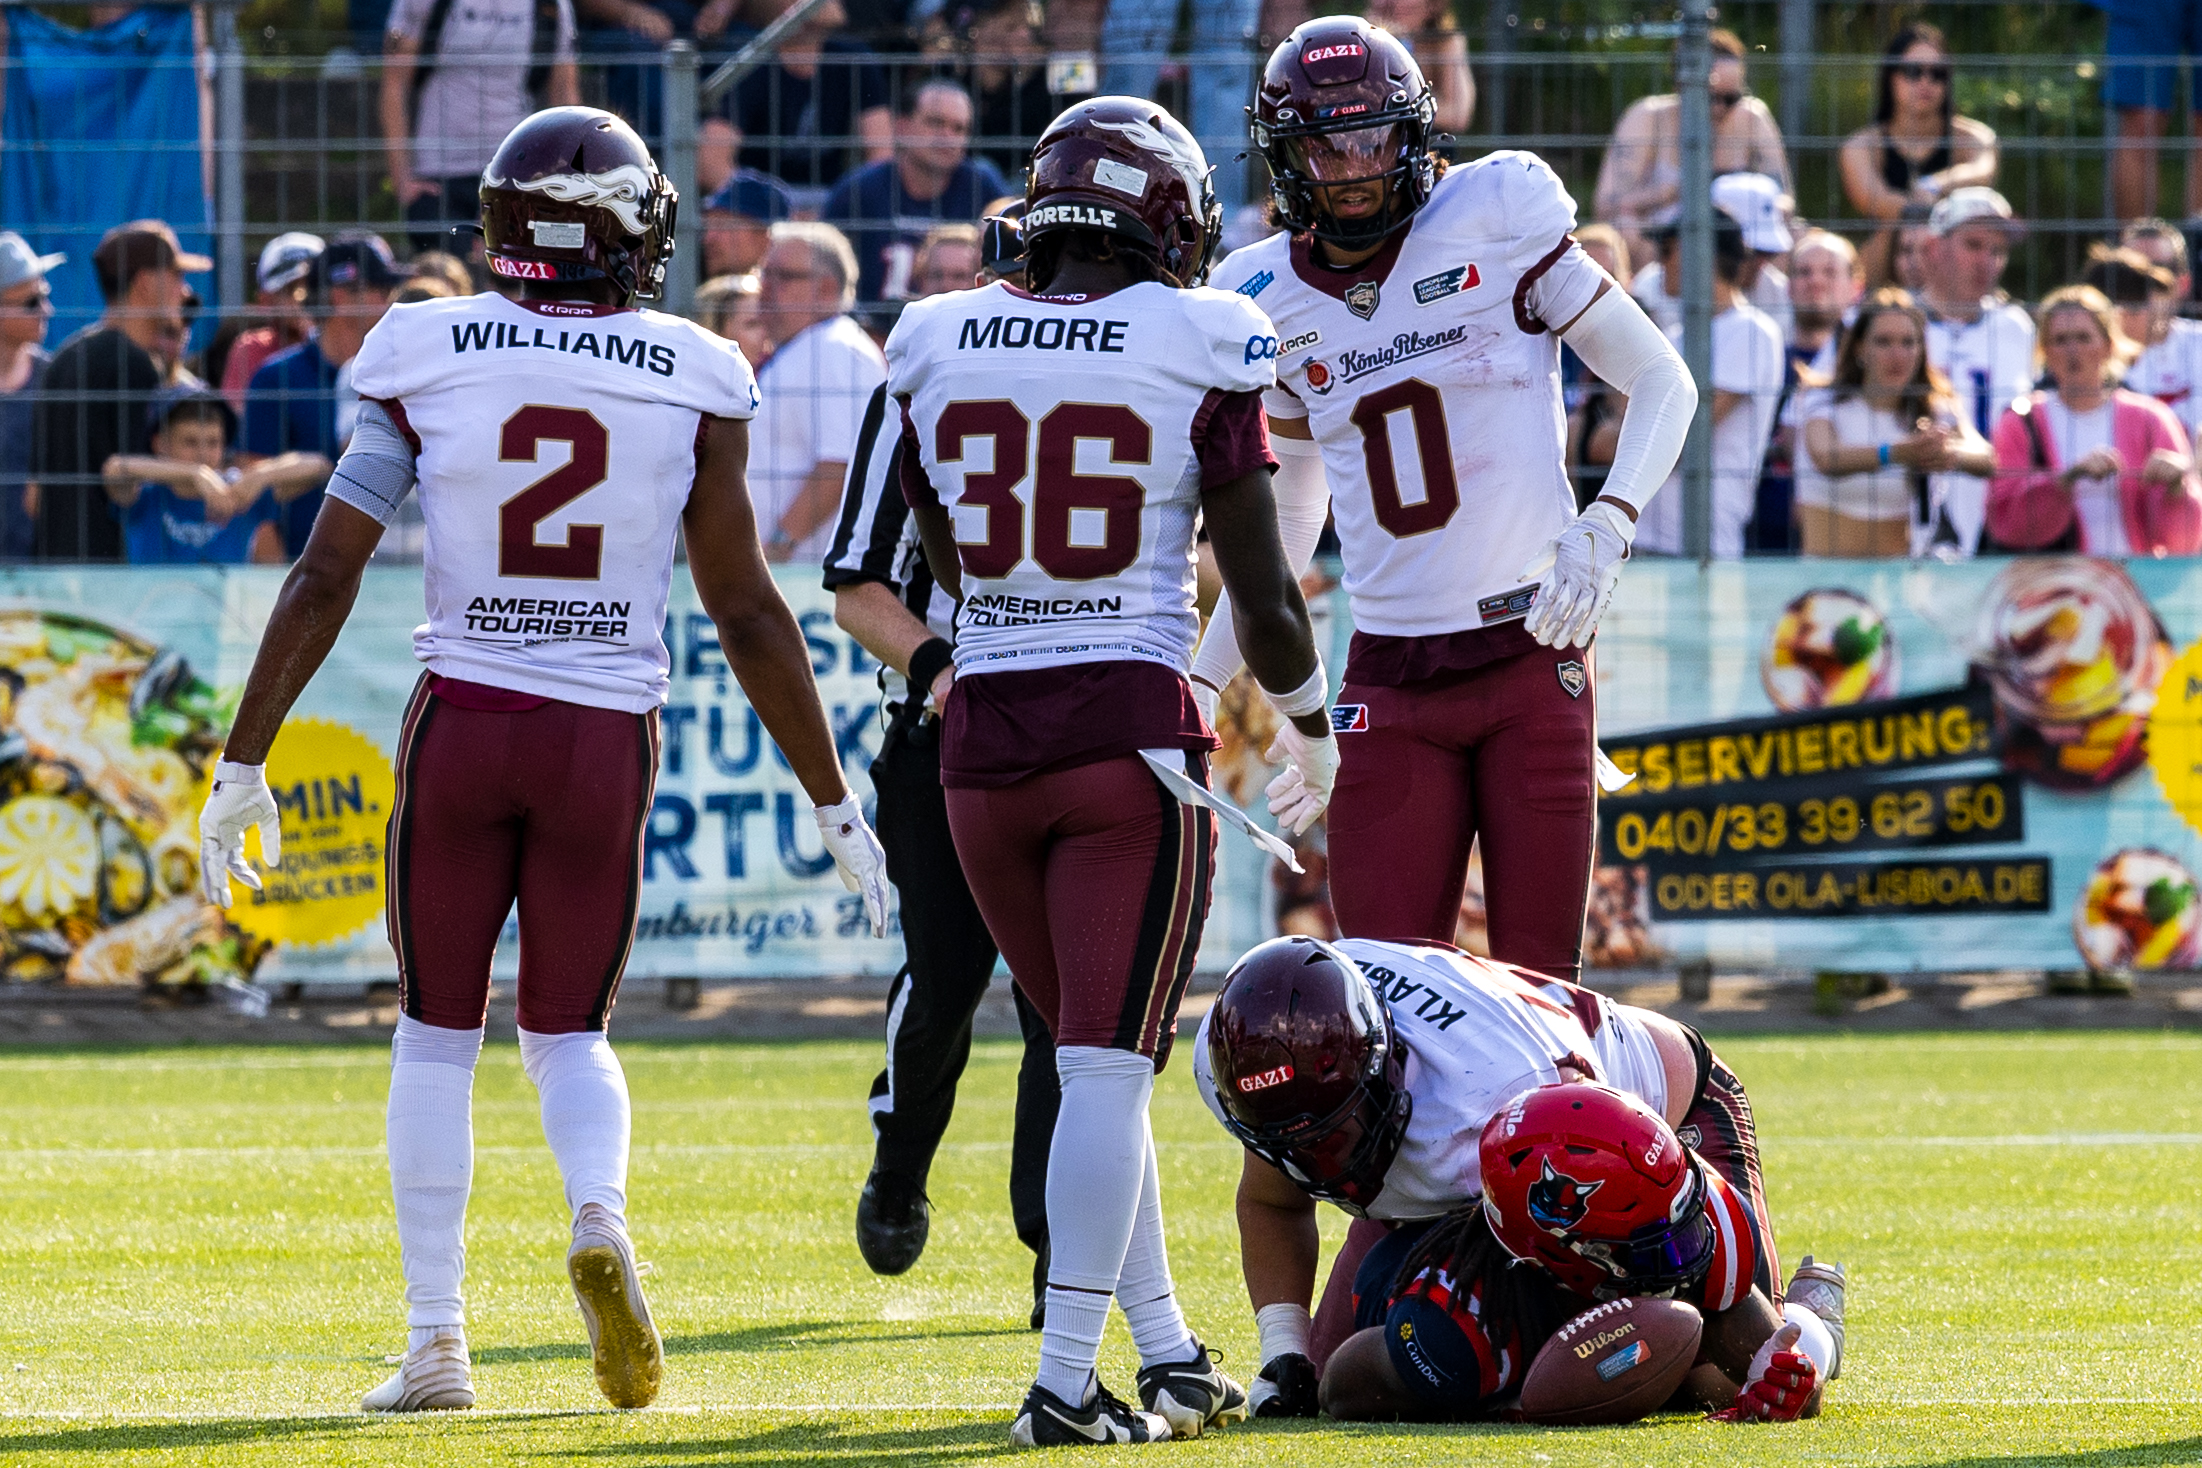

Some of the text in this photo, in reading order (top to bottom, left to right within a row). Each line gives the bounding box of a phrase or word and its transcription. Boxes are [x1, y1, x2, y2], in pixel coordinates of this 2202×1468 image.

[1026, 206, 1117, 231] FORELLE
[452, 321, 677, 377] WILLIAMS
[958, 316, 1129, 353] MOORE
[1350, 377, 1460, 538] 0
[499, 403, 609, 581] 2
[935, 398, 1152, 581] 36
[465, 614, 628, 637] TOURISTER
[467, 597, 631, 617] AMERICAN
[966, 595, 1122, 615] AMERICAN
[1602, 705, 1989, 797] ESERVIERUNG:
[1615, 783, 2006, 860] 040/33 39 62 50
[1655, 863, 2045, 912] ODER OLA-LISBOA.DE
[1573, 1322, 1637, 1359] Wilson
